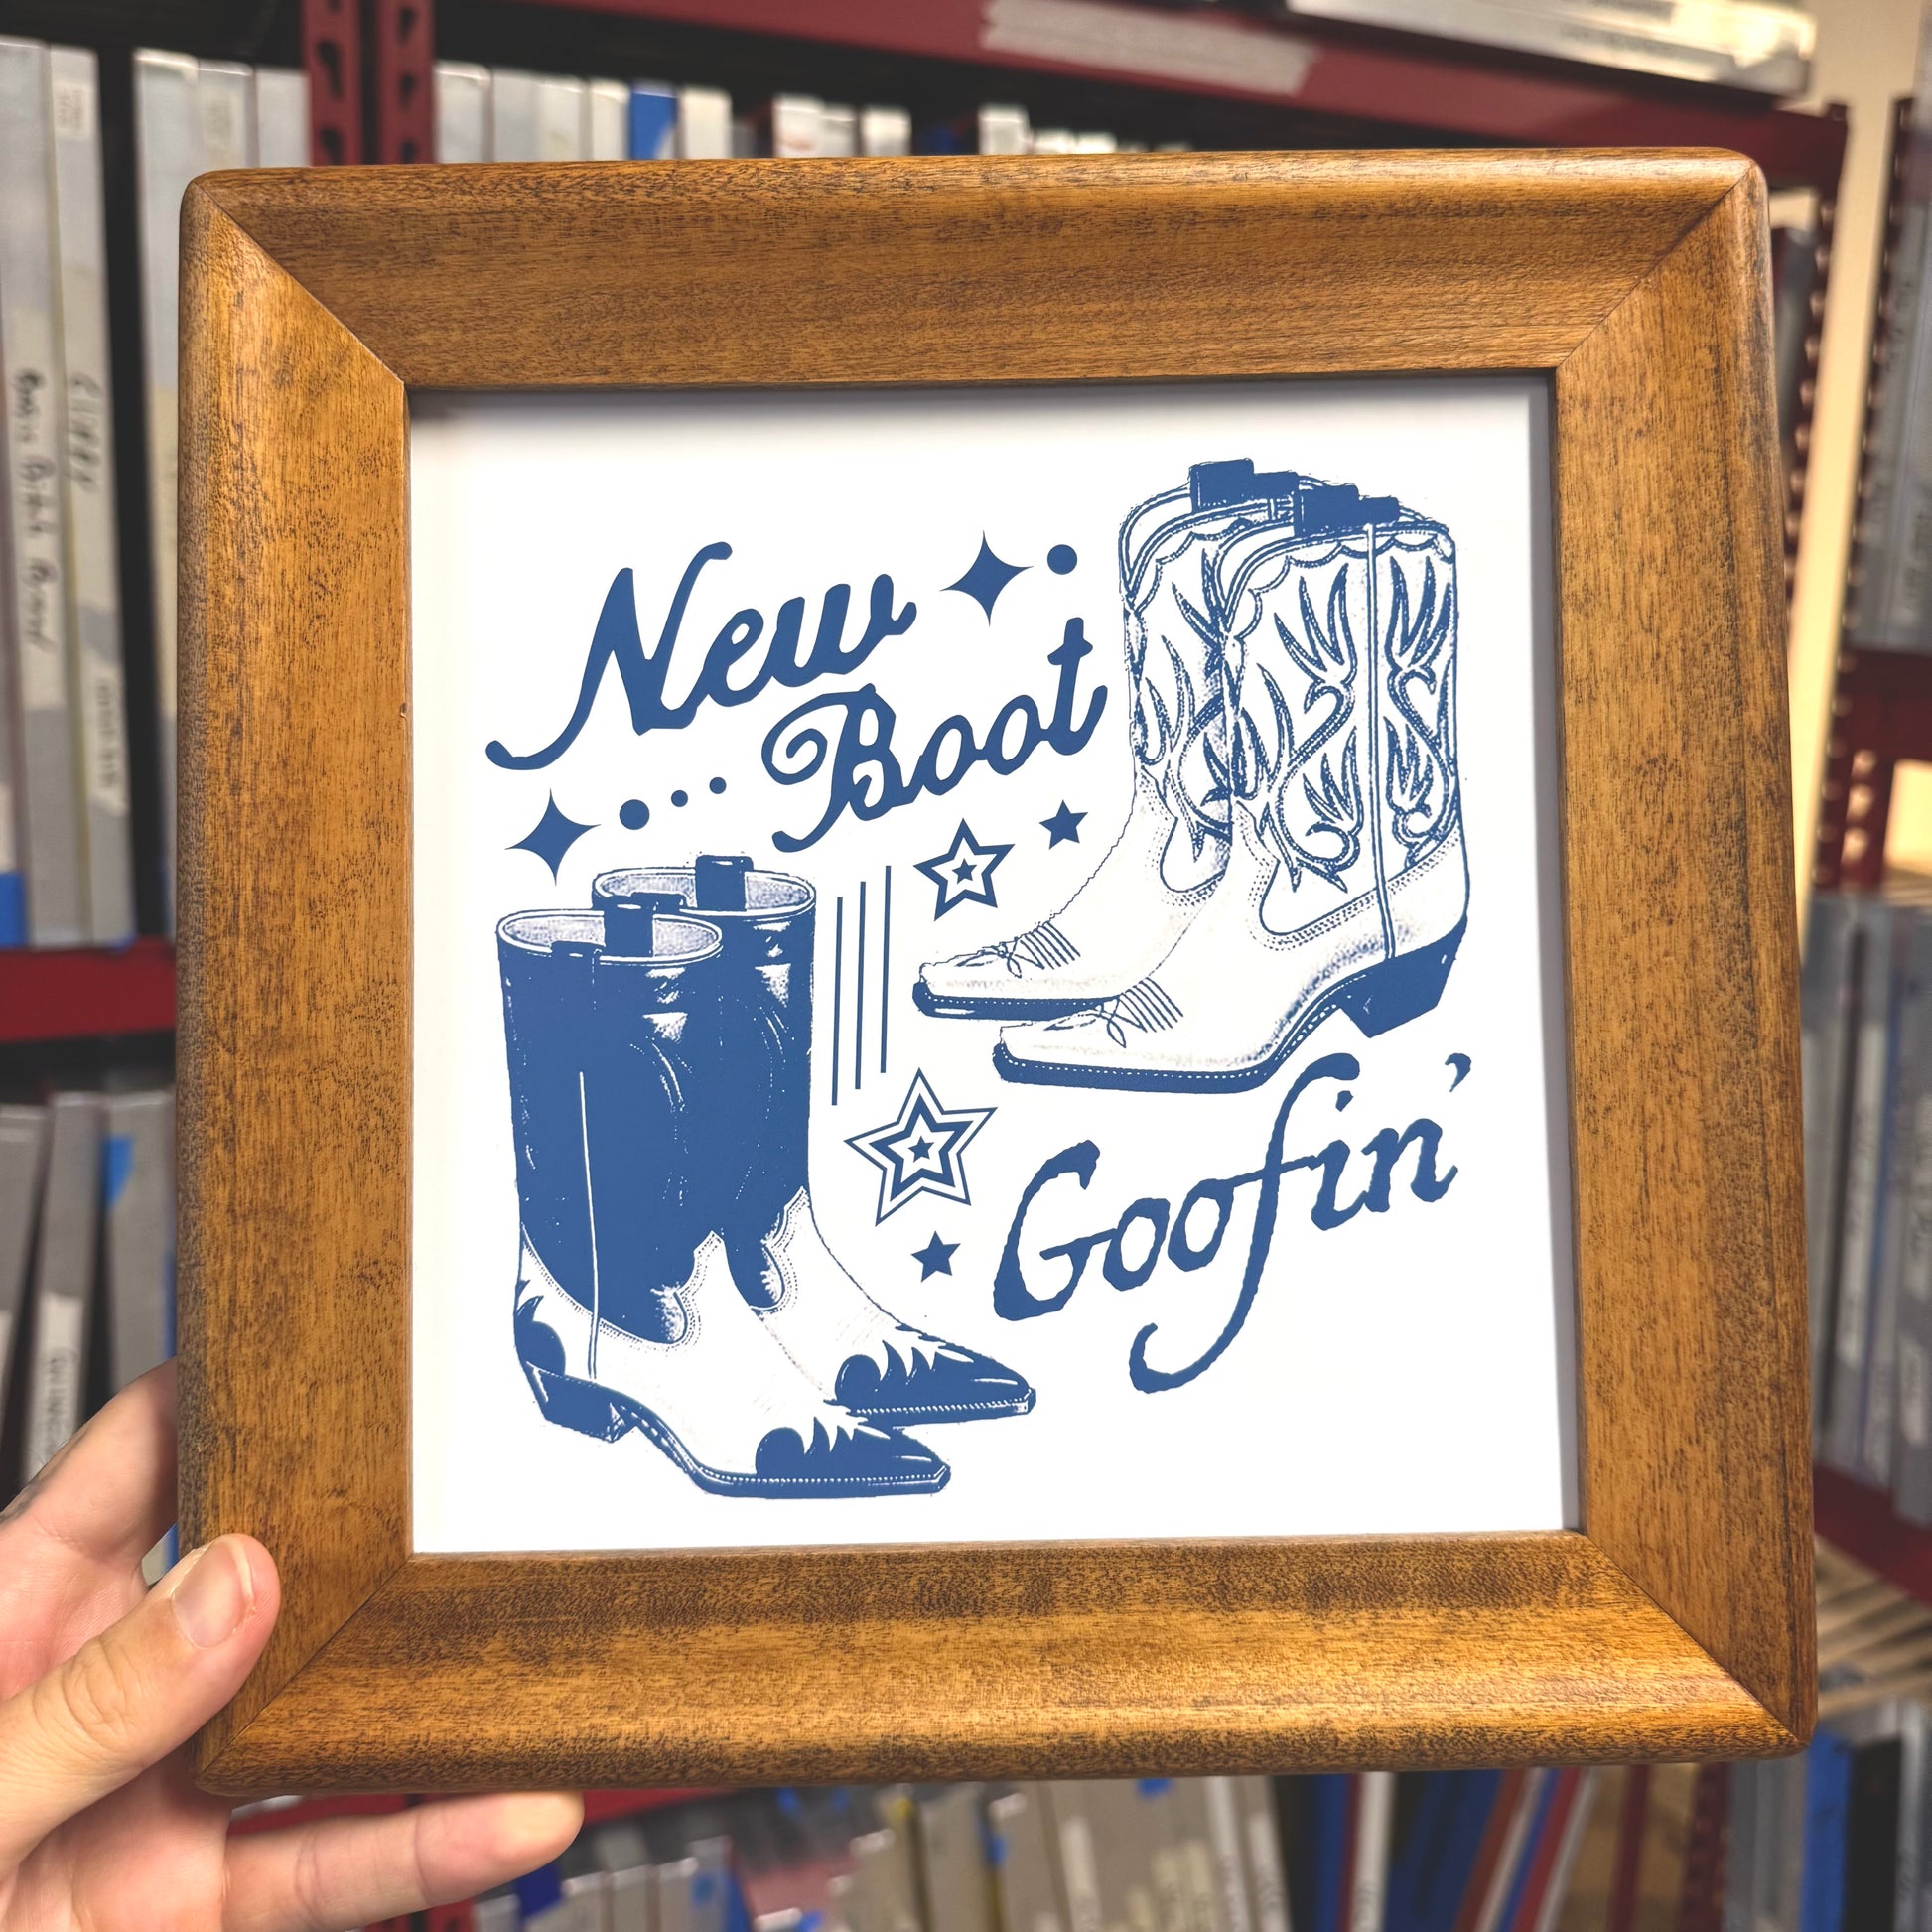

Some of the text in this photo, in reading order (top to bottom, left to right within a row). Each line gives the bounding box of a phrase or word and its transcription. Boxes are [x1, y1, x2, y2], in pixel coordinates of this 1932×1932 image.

[486, 541, 916, 770] New
[761, 617, 1107, 853] Boot
[994, 1052, 1472, 1394] Goofin'
